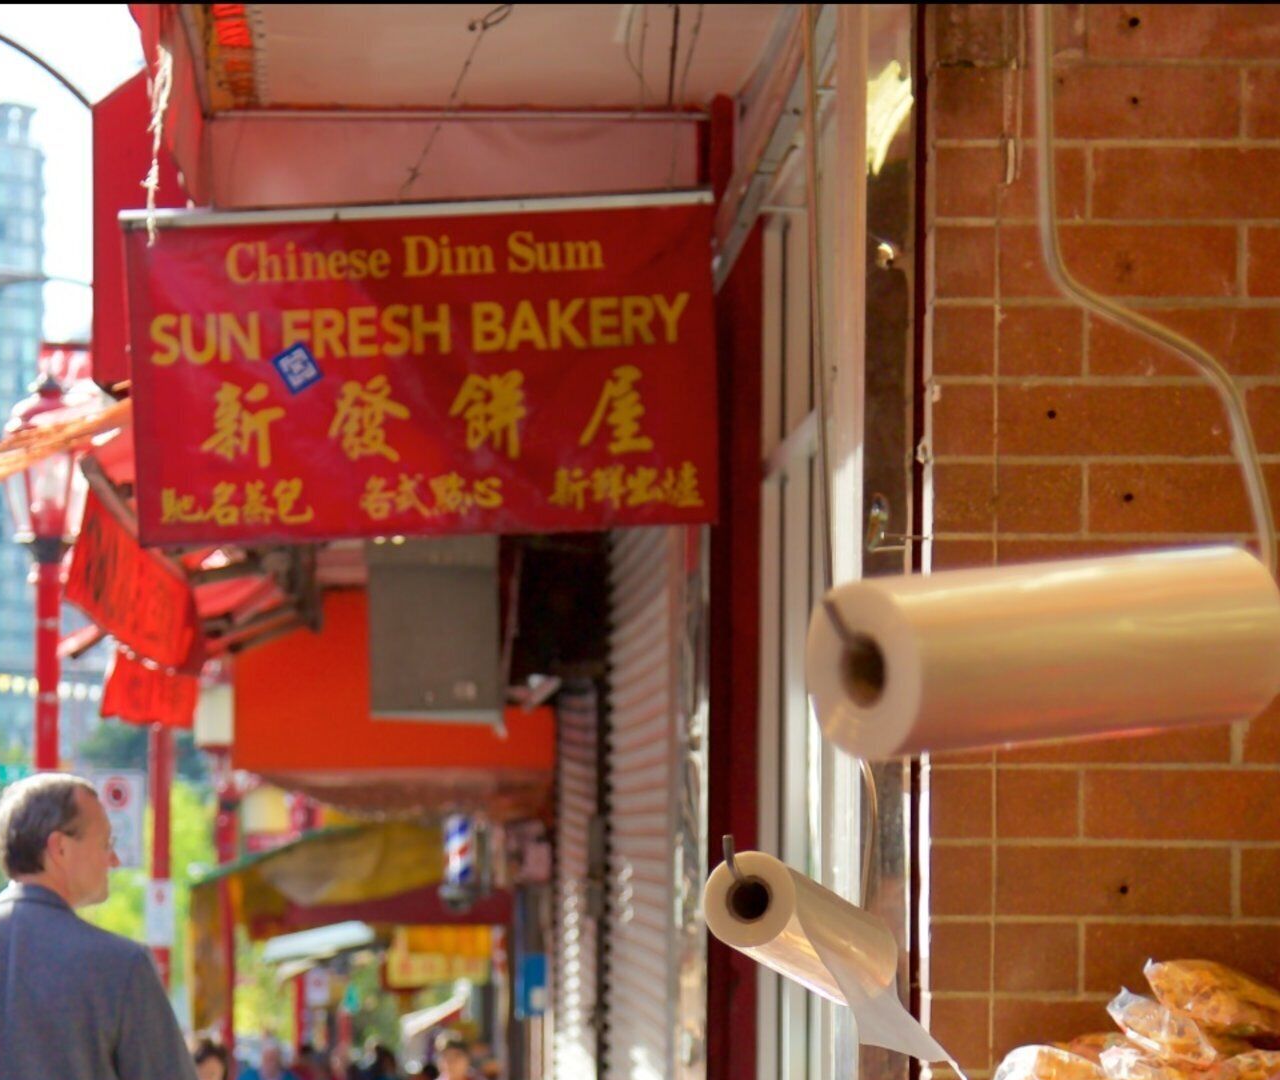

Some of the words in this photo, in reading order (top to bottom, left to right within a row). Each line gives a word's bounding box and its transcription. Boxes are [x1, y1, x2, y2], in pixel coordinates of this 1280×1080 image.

[225, 240, 392, 285] Chinese
[402, 234, 495, 278] Dim
[506, 231, 604, 274] Sum
[149, 311, 260, 367] SUN
[282, 303, 452, 358] FRESH
[471, 293, 690, 354] BAKERY
